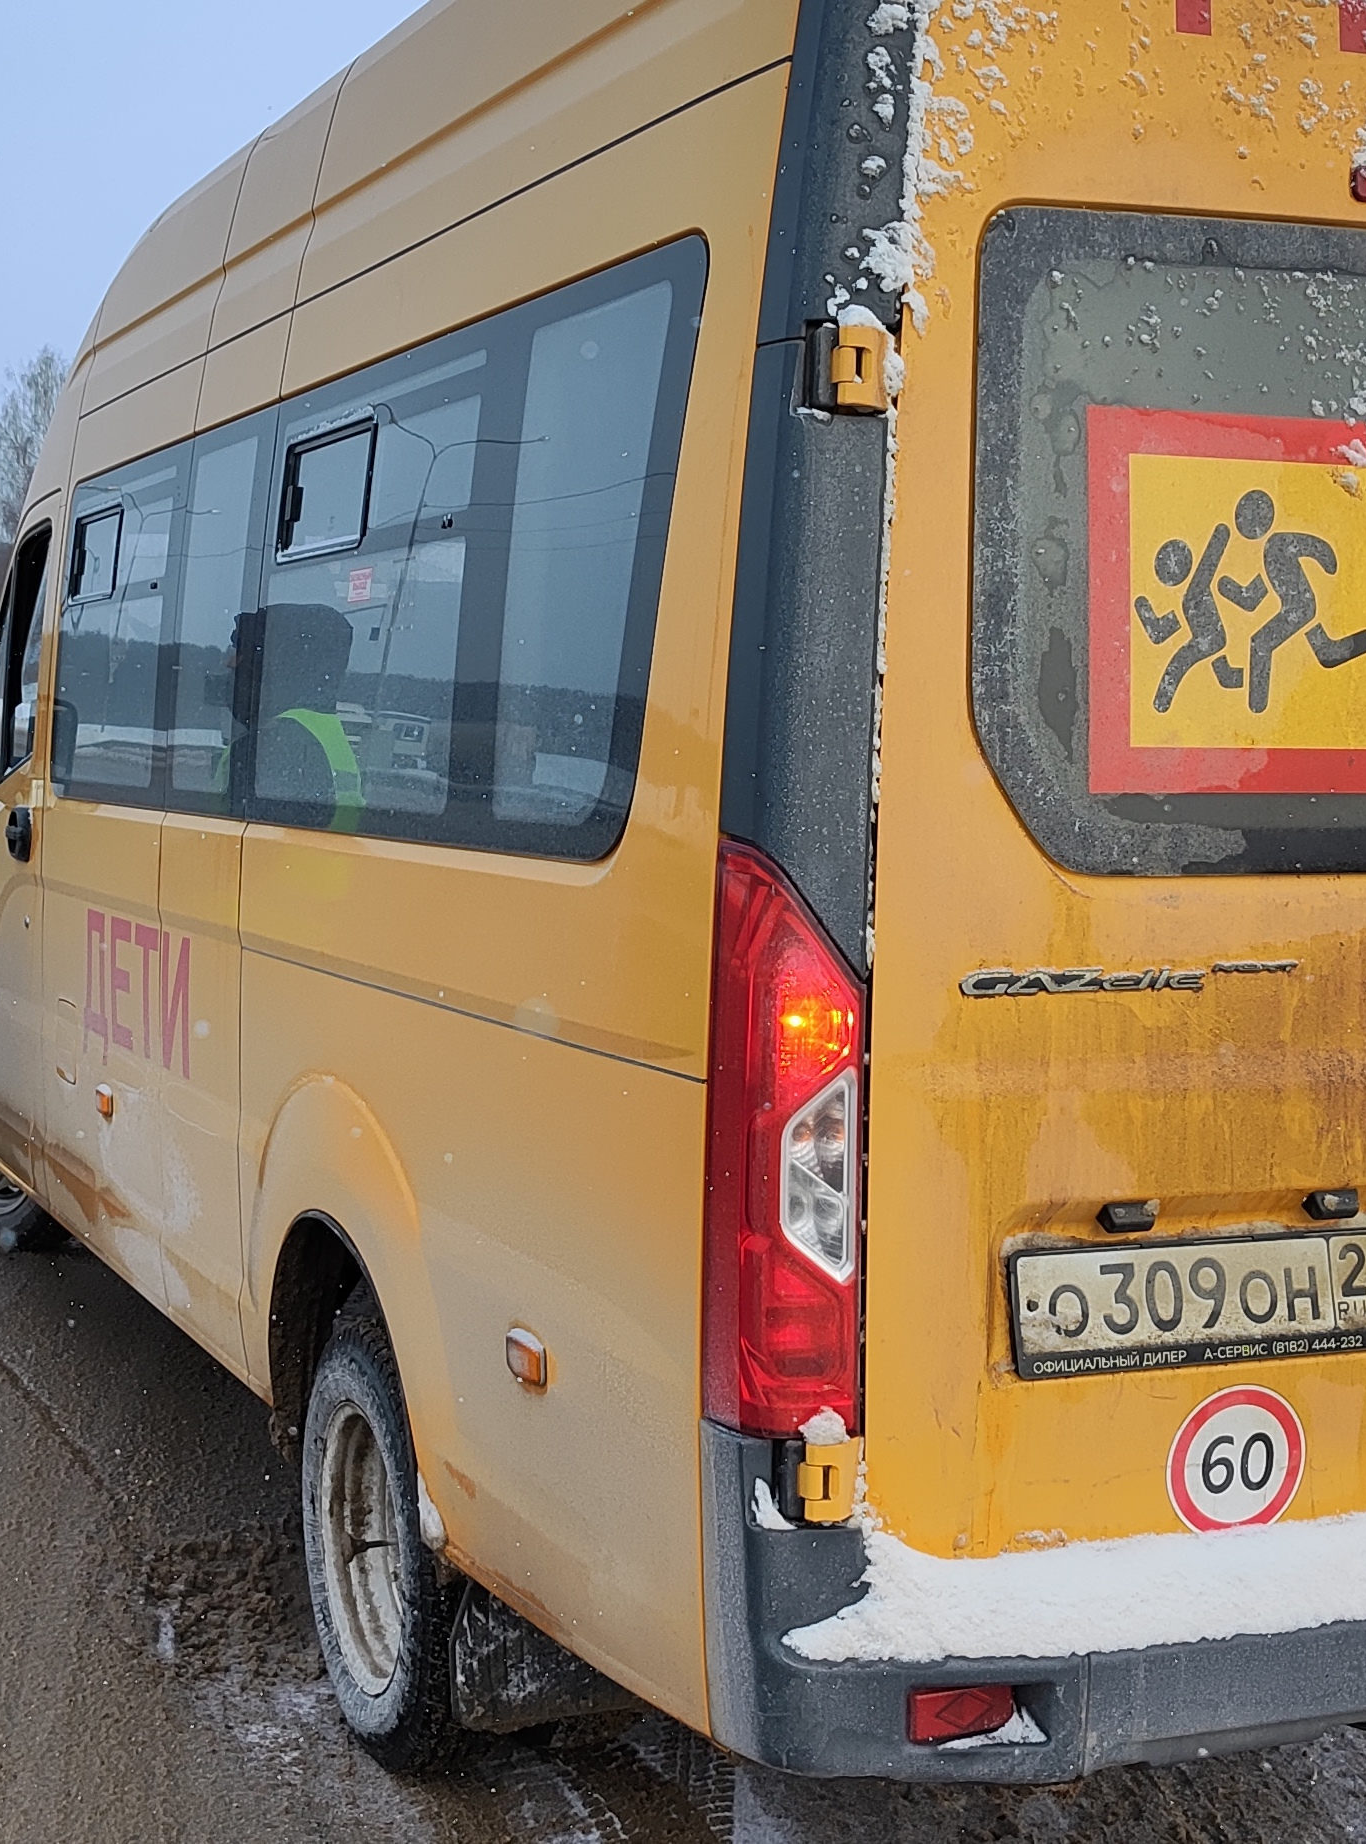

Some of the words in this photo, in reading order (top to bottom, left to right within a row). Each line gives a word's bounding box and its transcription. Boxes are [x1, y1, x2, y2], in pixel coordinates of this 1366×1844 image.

[83, 907, 191, 1080] ДЕТИ
[959, 967, 1206, 998] GAZelle
[1033, 1351, 1140, 1374] ОФИЦИАЛЬНЫЙ
[1142, 1350, 1187, 1367] ДИЛЕР
[1203, 1343, 1268, 1361] А-СЕРВИС
[1272, 1340, 1309, 1356] (8182)
[1311, 1336, 1363, 1351] 444-232
[1201, 1432, 1274, 1495] 60
